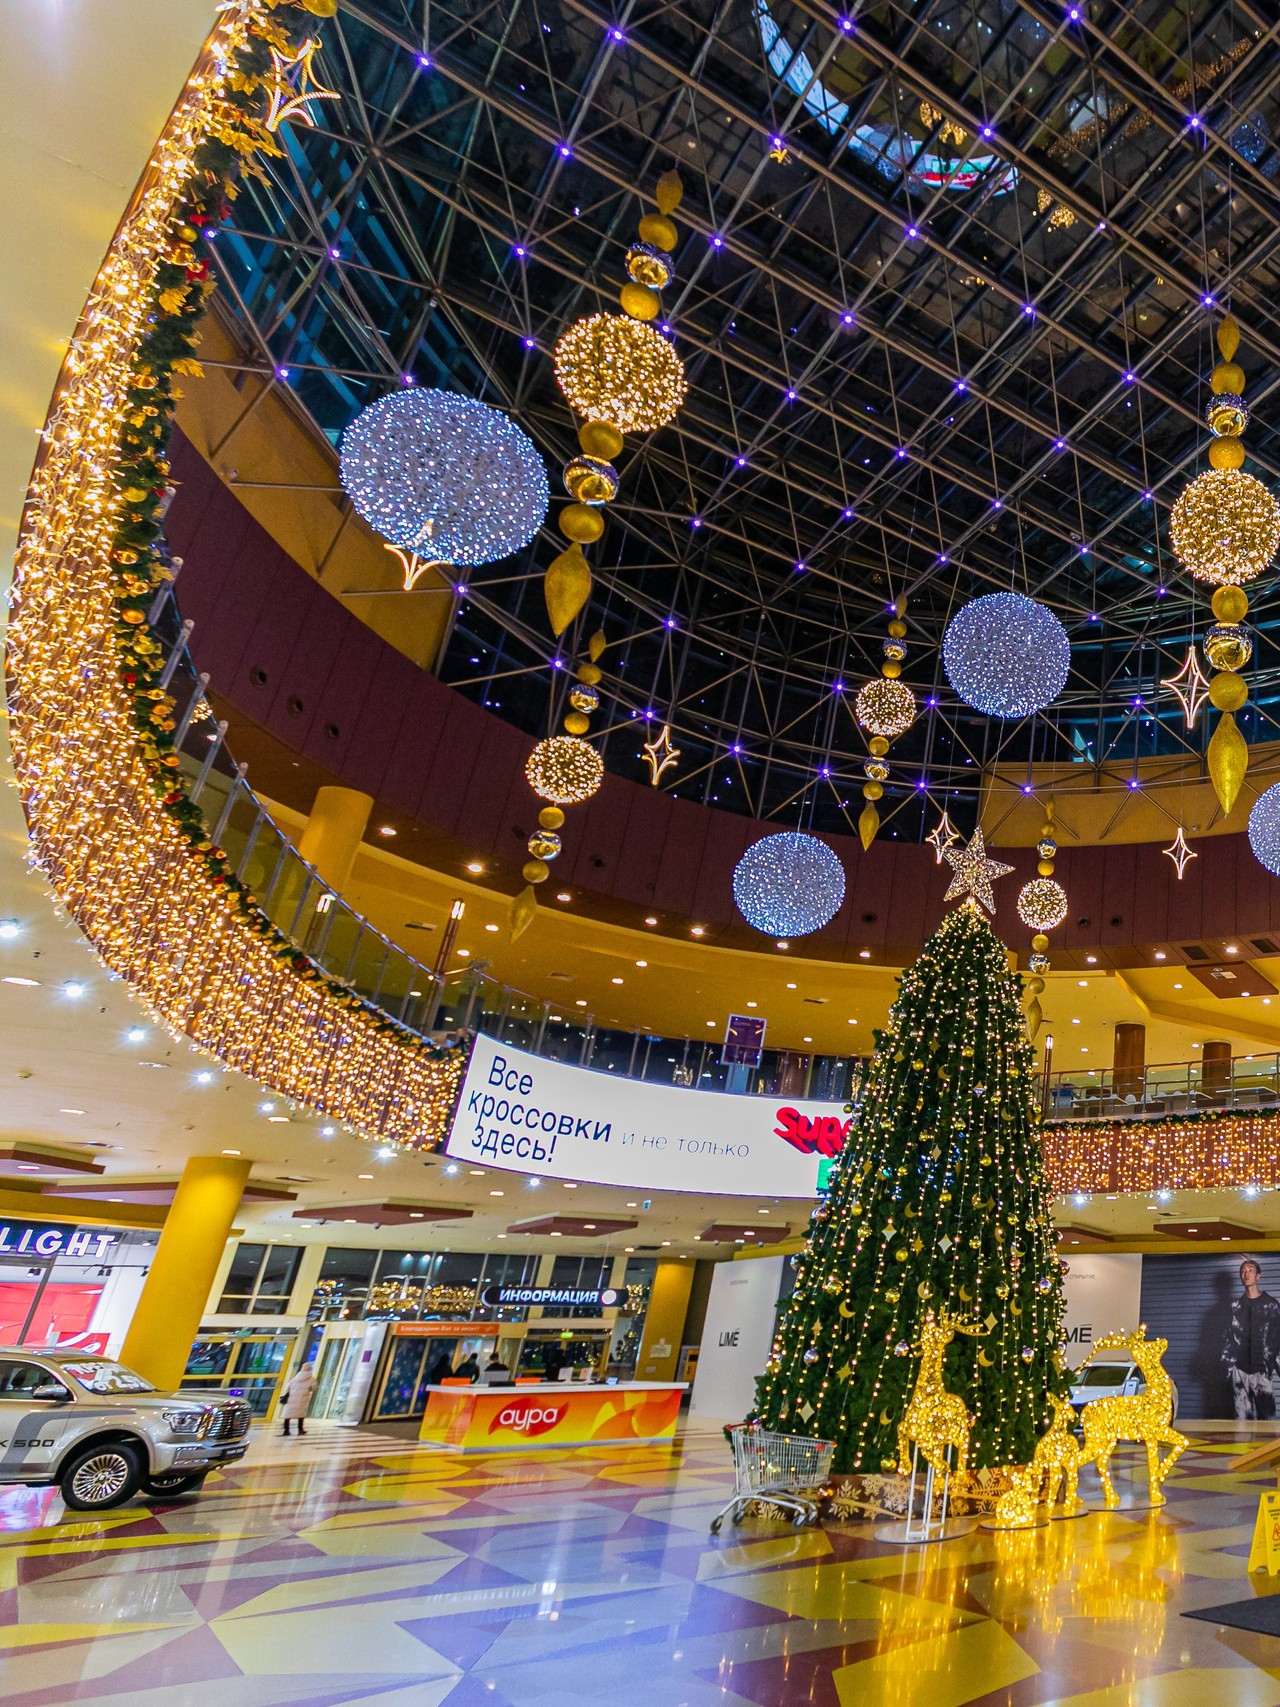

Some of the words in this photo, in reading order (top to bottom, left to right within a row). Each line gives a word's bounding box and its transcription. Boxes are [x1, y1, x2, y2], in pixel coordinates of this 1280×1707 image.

[488, 1055, 533, 1095] Все
[468, 1090, 612, 1142] кроссовки
[472, 1125, 557, 1163] здесь!
[622, 1132, 635, 1145] и
[642, 1135, 668, 1150] не
[678, 1138, 750, 1158] только
[0, 1227, 115, 1257] LIGHT
[500, 1289, 599, 1304] ИНФОРМАЦИЯ
[499, 1408, 558, 1430] аура
[13, 1439, 55, 1448] 500
